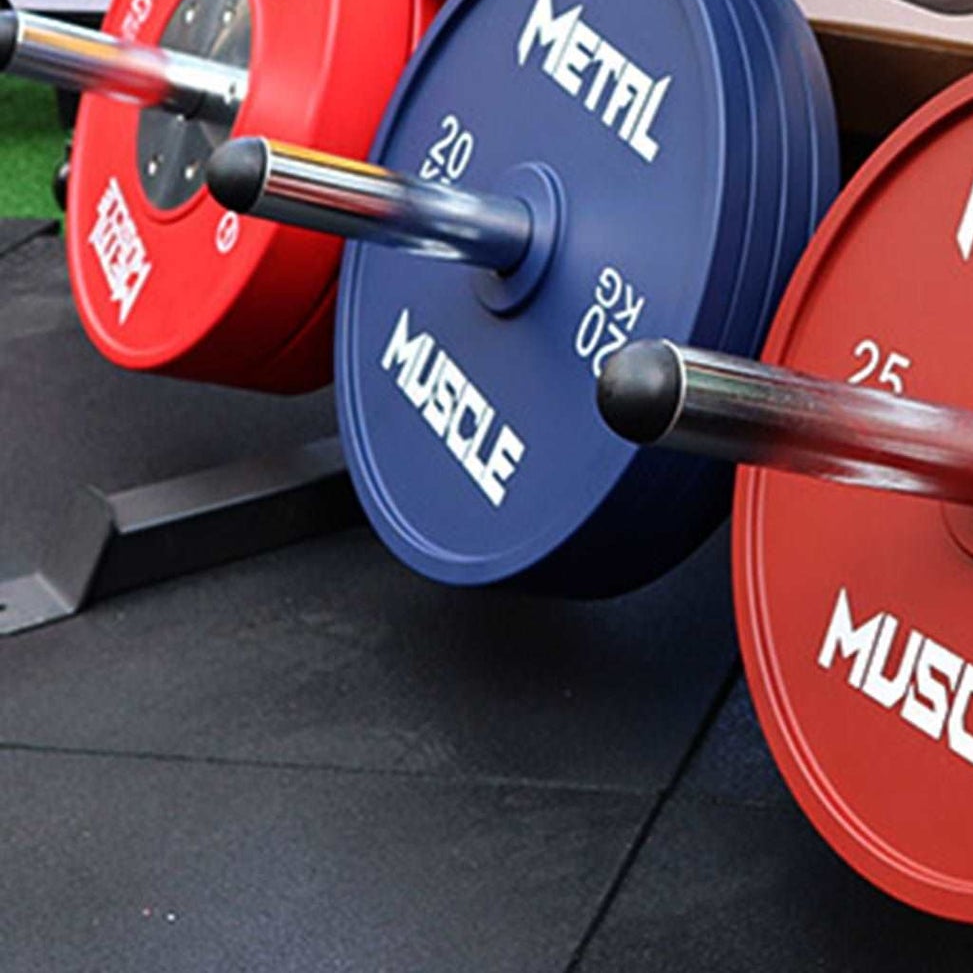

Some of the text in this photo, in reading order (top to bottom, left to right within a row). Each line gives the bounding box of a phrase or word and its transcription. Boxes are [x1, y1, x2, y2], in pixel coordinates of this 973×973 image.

[429, 114, 475, 180] 20
[595, 266, 646, 332] KG
[575, 304, 627, 378] 20
[848, 339, 912, 394] 25
[381, 308, 525, 507] MUSCLE
